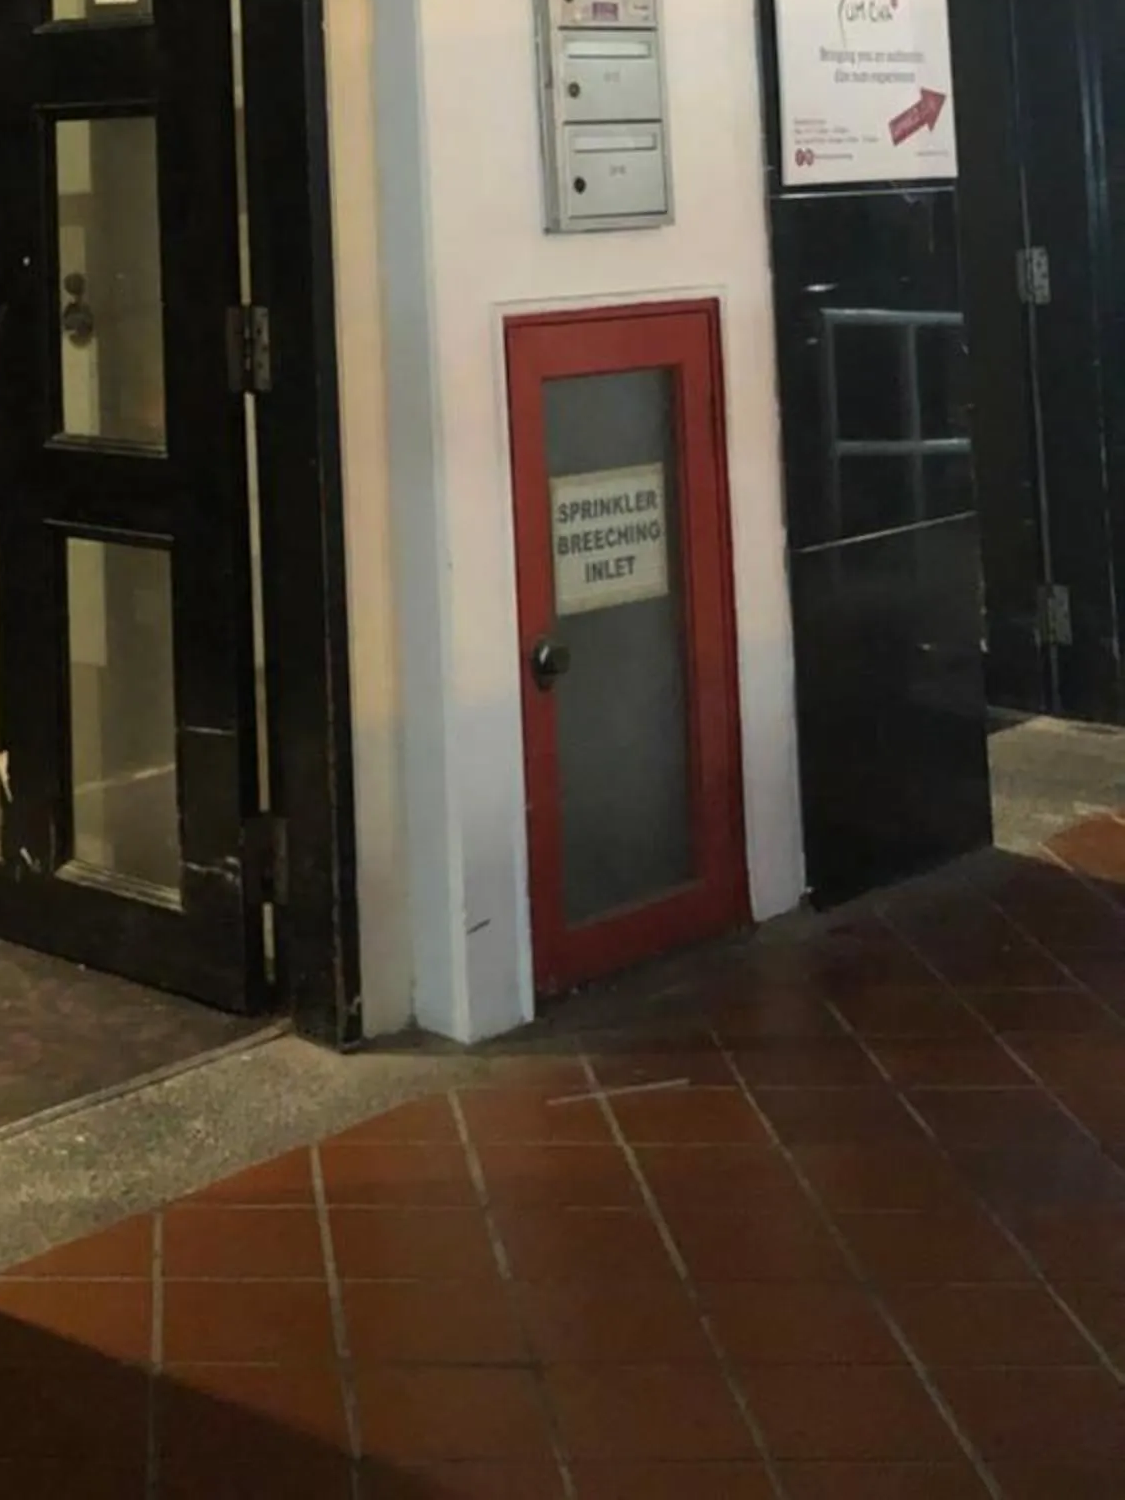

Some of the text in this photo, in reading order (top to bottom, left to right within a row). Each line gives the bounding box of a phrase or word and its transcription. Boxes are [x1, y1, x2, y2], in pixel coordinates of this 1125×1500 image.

[557, 490, 658, 525] SPRINKLER
[557, 520, 661, 556] BREECHING
[584, 555, 636, 584] INLET
